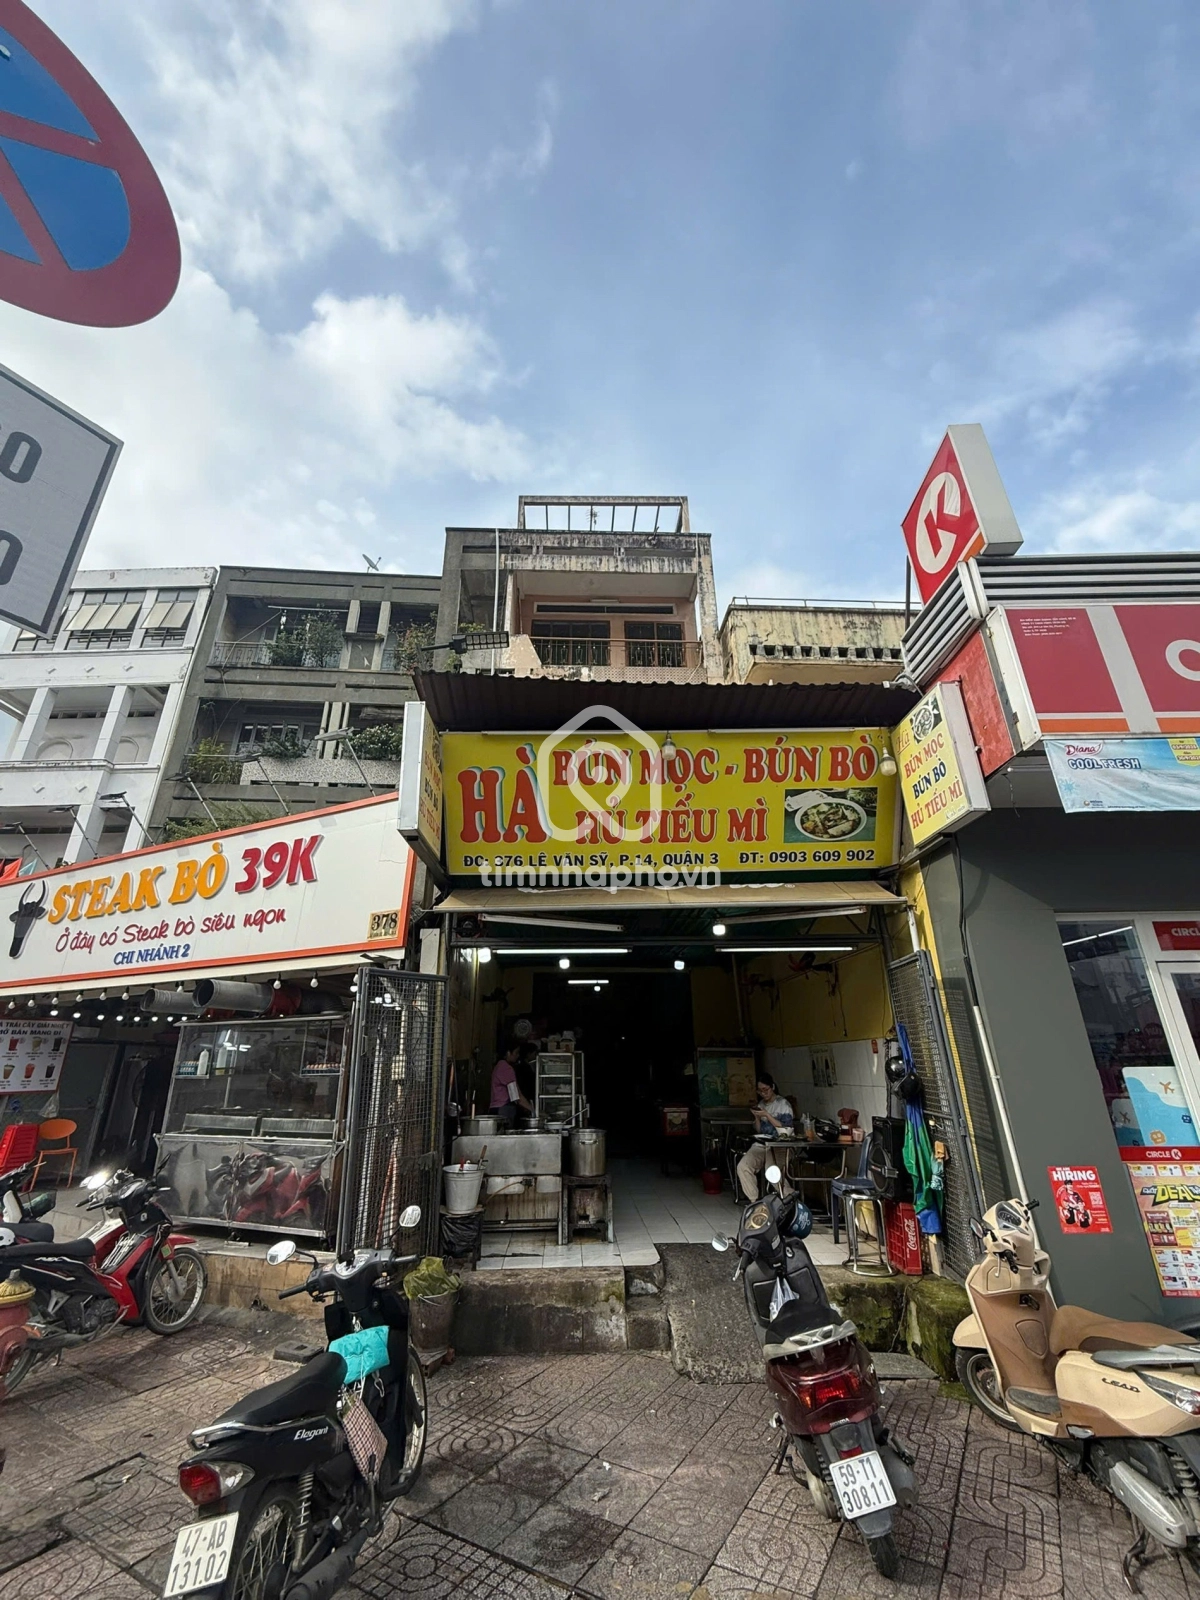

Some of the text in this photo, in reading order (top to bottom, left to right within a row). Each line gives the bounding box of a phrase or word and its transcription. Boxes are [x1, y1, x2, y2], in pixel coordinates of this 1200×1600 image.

[552, 738, 633, 786] BÚN
[638, 747, 720, 793] MỌC
[742, 735, 823, 785] BÚN
[828, 734, 880, 782] BÒ
[903, 732, 945, 779] BÚN MỌC
[1064, 744, 1096, 756] Diana
[1068, 757, 1142, 770] COOL FRESH
[457, 742, 553, 844] HÀ
[912, 757, 947, 800] BÚN BÒ
[910, 775, 963, 830] HỦ TIẾU MÌ
[575, 792, 770, 845] HỦ TIẾU MÌ
[528, 852, 547, 867] LÊ
[553, 852, 584, 867] VĂN
[588, 851, 615, 868] SỸ,
[619, 853, 658, 869] P.14,
[662, 850, 704, 867] QUẬN
[709, 853, 719, 865] 3
[739, 849, 875, 864] ĐT: 0903 609 902
[48, 834, 324, 924] STEAK BÒ 39K
[55, 908, 287, 954] Ở đây có Steak bò siêu ngon
[371, 912, 398, 931] 378
[113, 943, 191, 965] CHI NHÁNH 2
[1145, 1148, 1182, 1160] CIRCLE K
[1052, 1170, 1096, 1181] HIRING
[1154, 1184, 1200, 1204] DEAL
[1101, 1377, 1140, 1392] LEAD
[293, 1426, 329, 1441] Elegant
[838, 1456, 877, 1487] 59-T1
[842, 1479, 891, 1513] 308.11
[182, 1520, 228, 1558] 47-AB
[170, 1550, 228, 1593] 131.02
